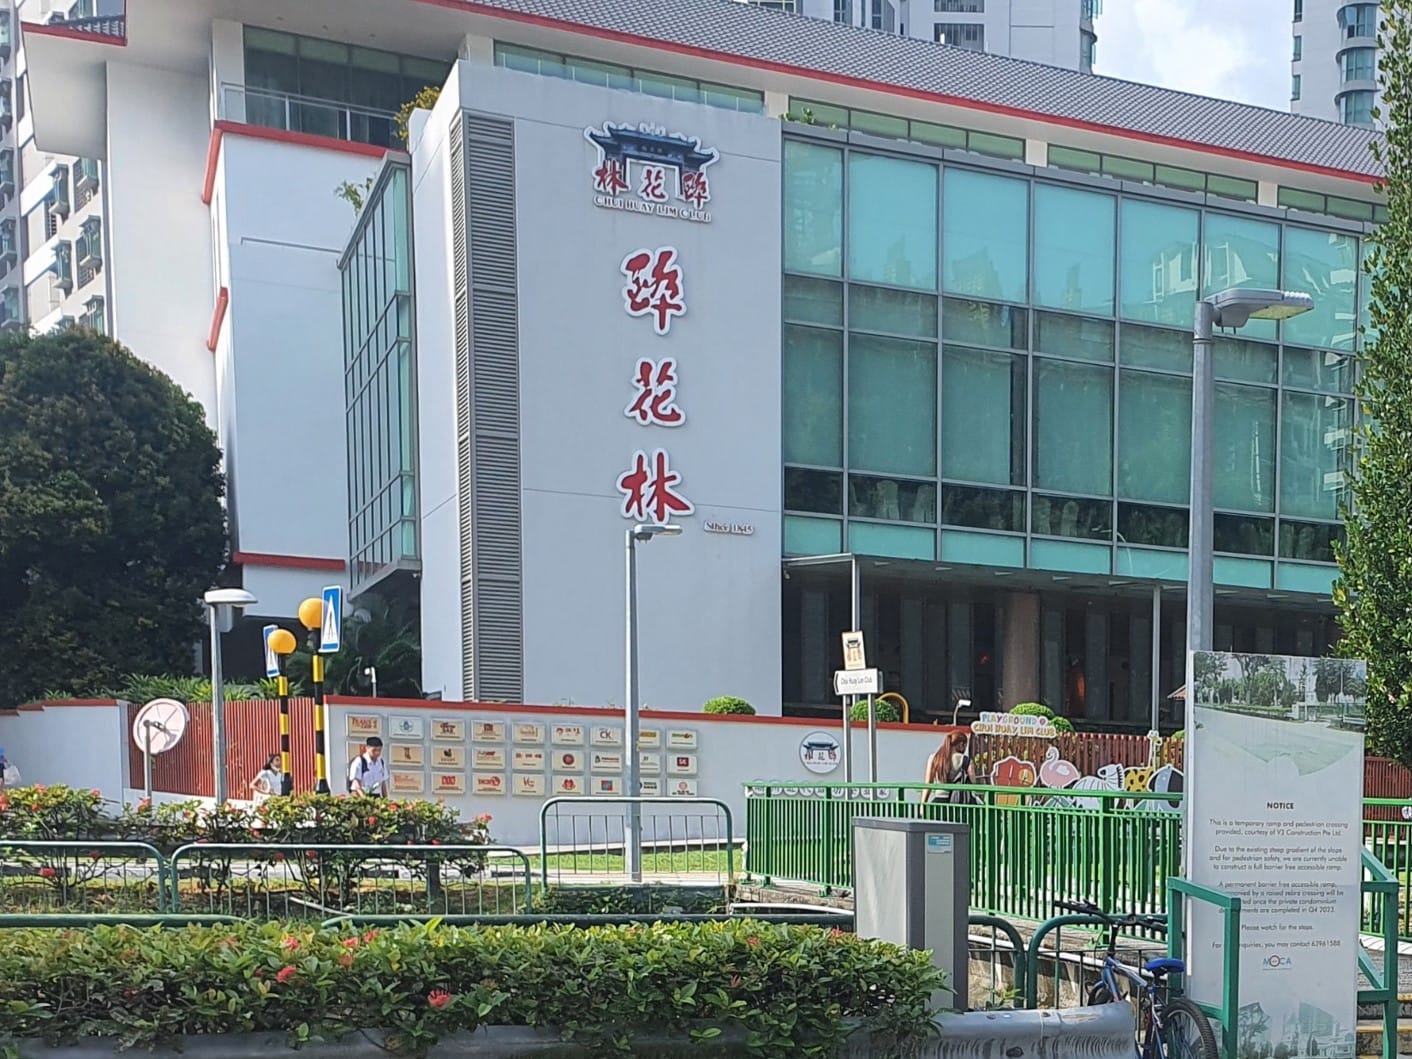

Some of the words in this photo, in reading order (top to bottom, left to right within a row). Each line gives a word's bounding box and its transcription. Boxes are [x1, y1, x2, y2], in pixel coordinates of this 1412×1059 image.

[594, 195, 623, 208] CHUI
[625, 199, 655, 213] HUAY
[656, 204, 677, 217] LIM
[679, 208, 711, 222] CLUB
[982, 713, 1037, 725] PLAYGROUND
[974, 723, 993, 732] CHUI
[995, 724, 1017, 734] HUAY
[1020, 726, 1033, 735] LIM
[1036, 727, 1054, 736] CLUB
[1266, 802, 1294, 810] NOTICE
[1209, 818, 1221, 826] This
[1234, 820, 1264, 828] temporary
[1295, 821, 1324, 829] pedestrian
[1244, 829, 1268, 837] courtesy
[1214, 845, 1227, 853] Due
[1327, 846, 1342, 855] slope
[1232, 854, 1263, 863] pedestrian
[1297, 863, 1325, 871] accessible
[1224, 881, 1257, 889] permanent
[1290, 880, 1319, 888] accessible
[1251, 889, 1260, 898] by
[1285, 889, 1301, 897] zebra
[1302, 890, 1325, 898] crossing
[1326, 889, 1336, 897] will
[1336, 889, 1344, 897] be
[1278, 898, 1298, 906] private
[1271, 906, 1301, 915] completed
[1308, 906, 1318, 914] Q4
[1241, 923, 1260, 931] Please
[1212, 941, 1222, 949] For
